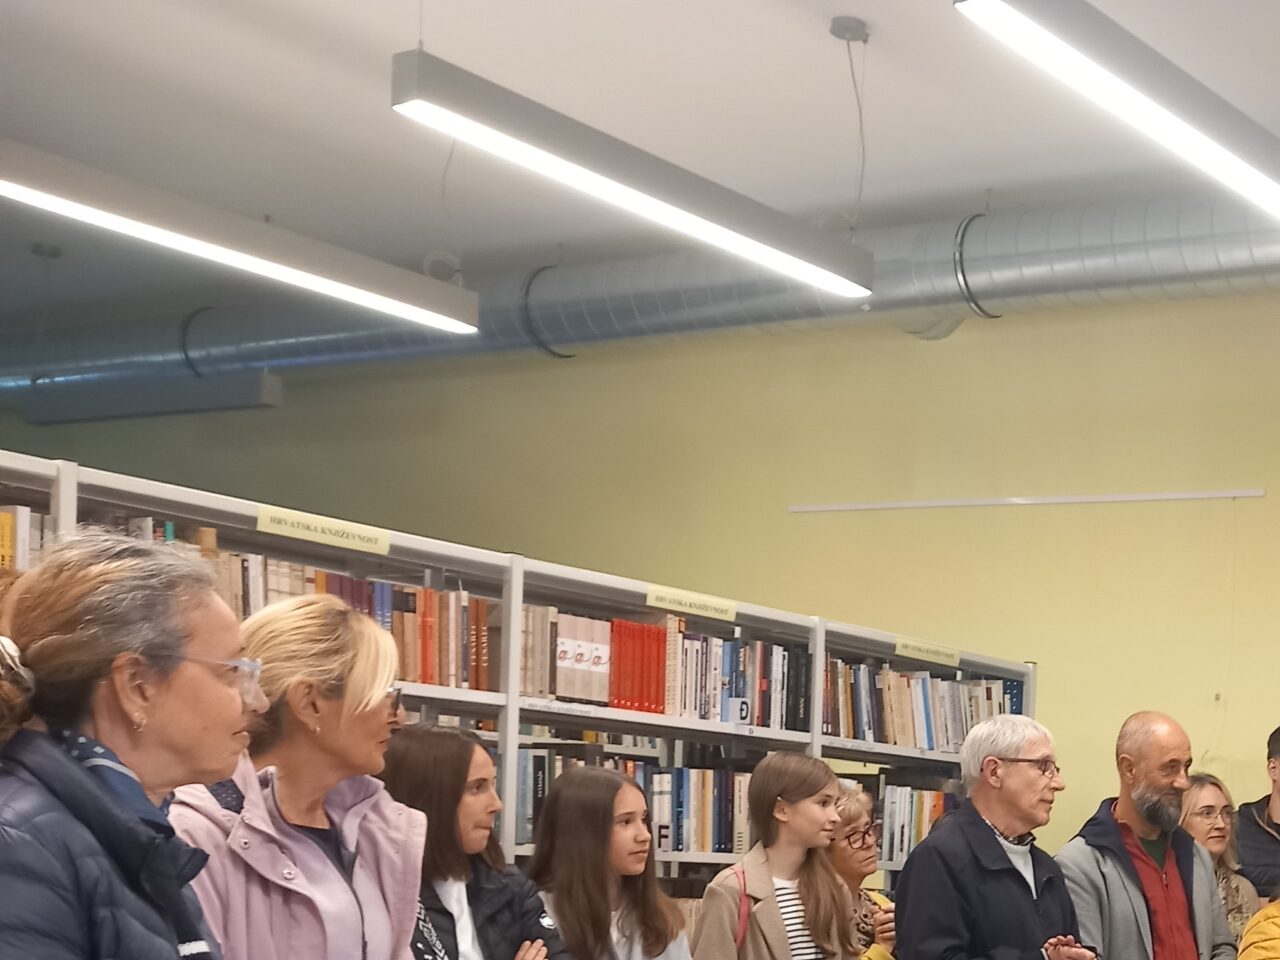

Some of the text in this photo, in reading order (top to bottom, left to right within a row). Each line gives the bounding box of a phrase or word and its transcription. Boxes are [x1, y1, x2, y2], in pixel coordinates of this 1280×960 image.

[269, 515, 380, 546] HRVATSKA KNJIŽEVNOST
[739, 700, 749, 721] Đ
[658, 824, 670, 849] F
